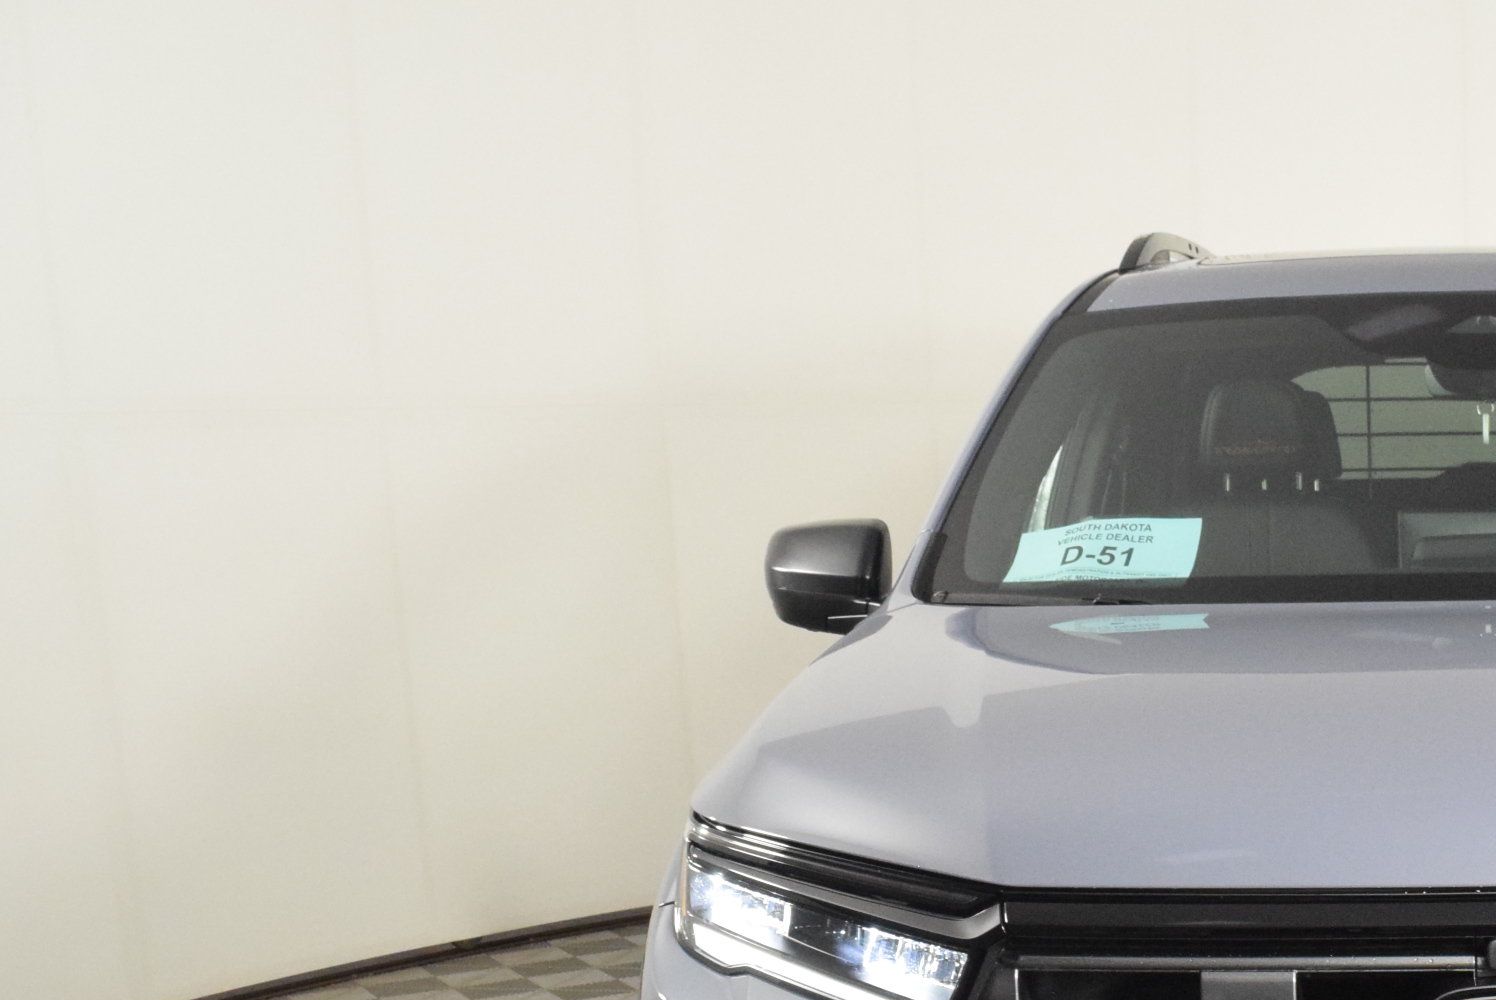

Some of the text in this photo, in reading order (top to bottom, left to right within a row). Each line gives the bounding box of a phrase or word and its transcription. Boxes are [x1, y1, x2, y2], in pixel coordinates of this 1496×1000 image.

[1065, 523, 1152, 536] SOUTH DAKOTA
[1058, 533, 1154, 545] VEHICLE DEALER
[1060, 545, 1134, 567] D-51
